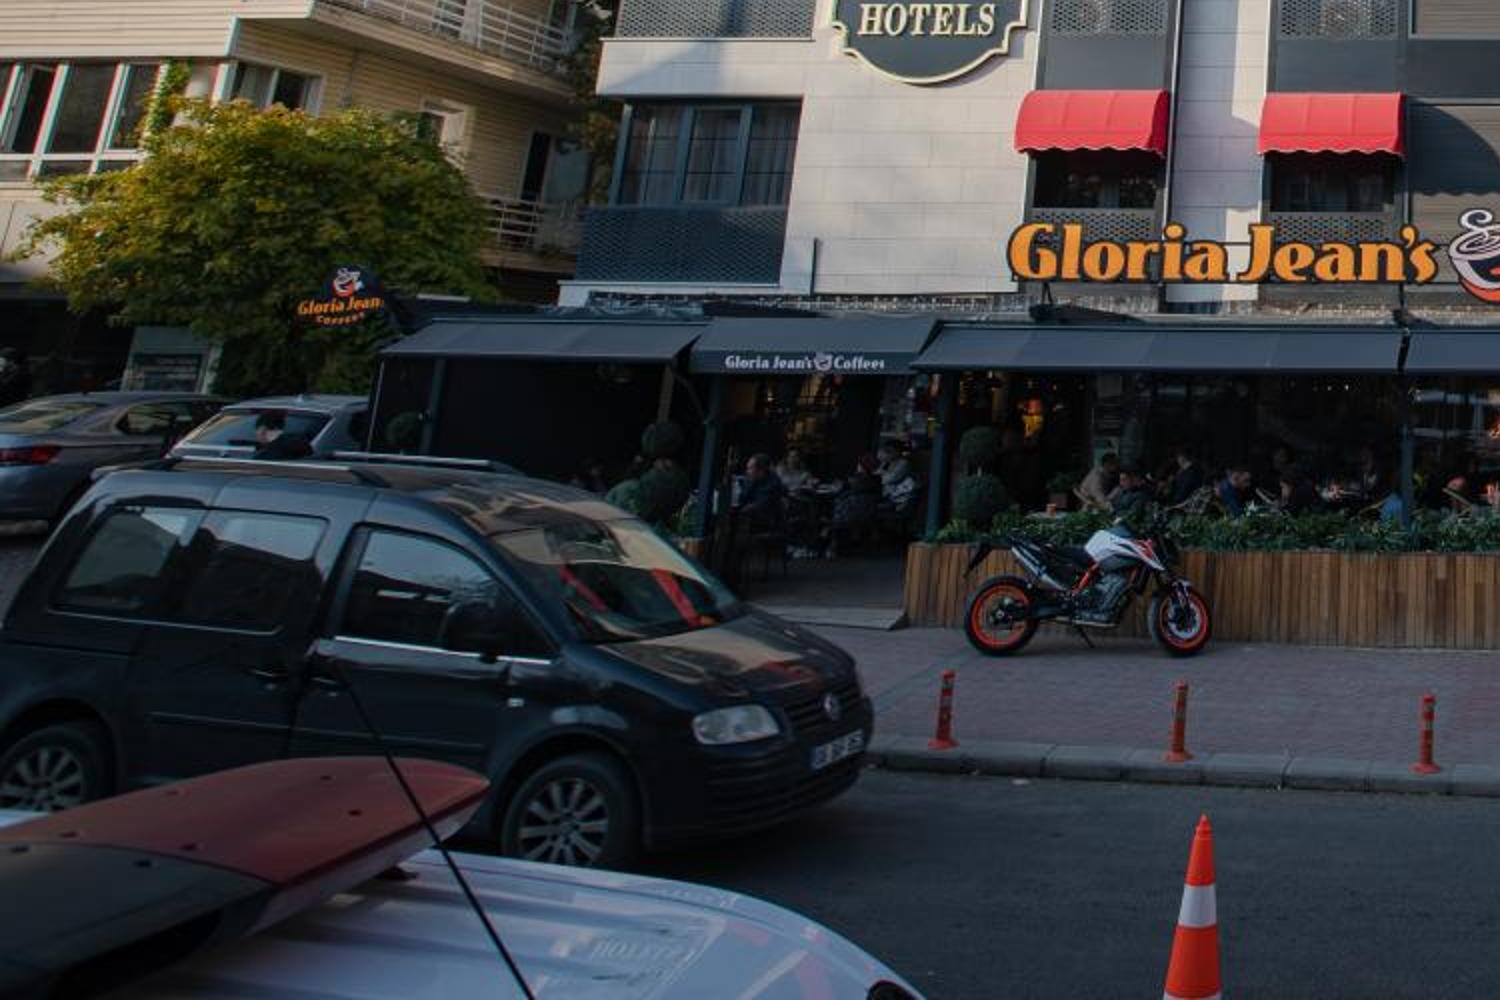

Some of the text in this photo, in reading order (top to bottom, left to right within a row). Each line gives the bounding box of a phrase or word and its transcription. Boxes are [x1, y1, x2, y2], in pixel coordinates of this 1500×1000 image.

[857, 3, 996, 36] HOTELS
[1008, 223, 1228, 283] Gloria
[1229, 223, 1438, 284] Jean's
[725, 355, 769, 369] Gloria
[834, 355, 885, 369] Coffees
